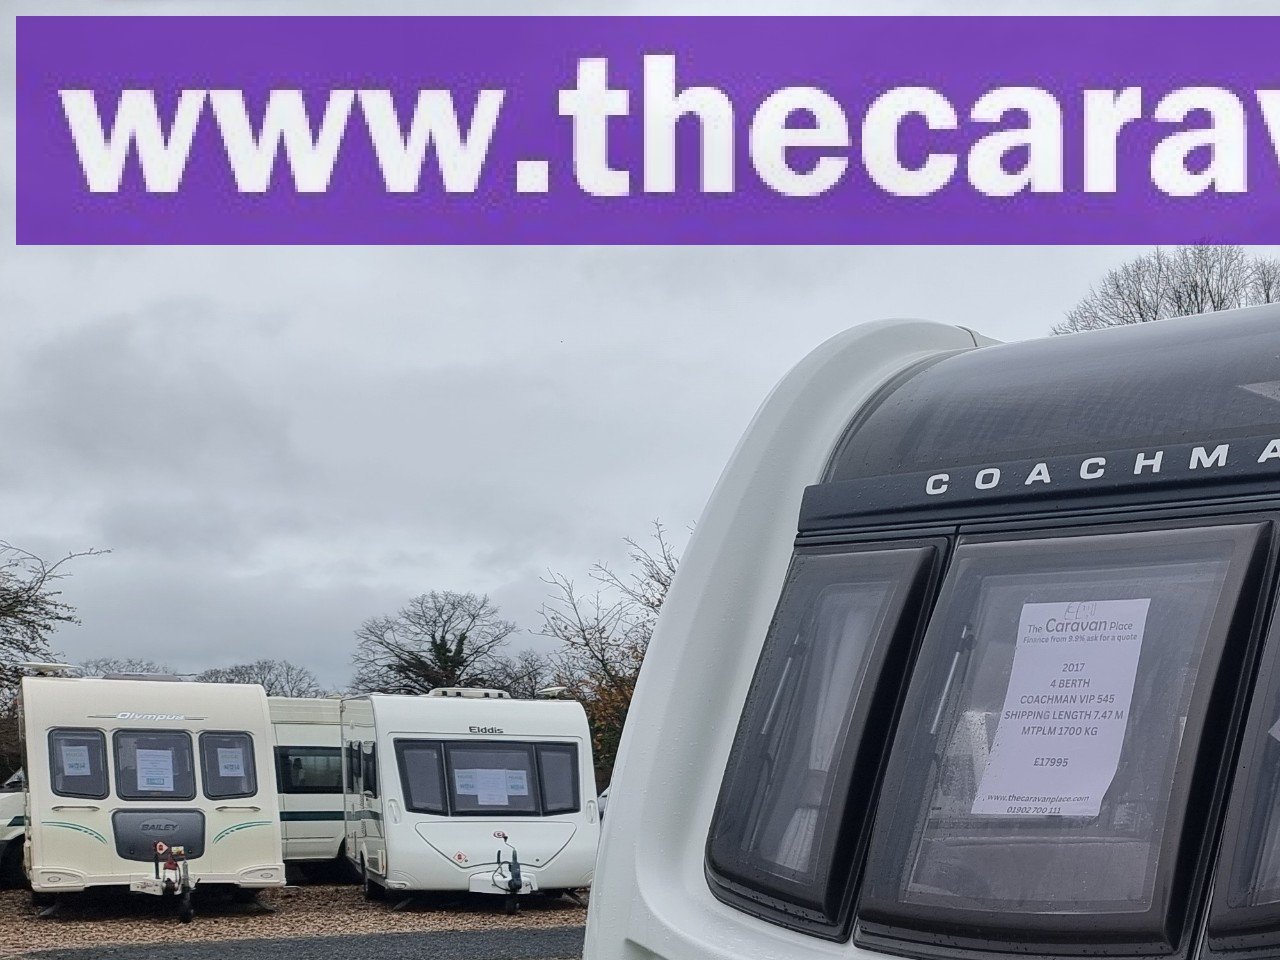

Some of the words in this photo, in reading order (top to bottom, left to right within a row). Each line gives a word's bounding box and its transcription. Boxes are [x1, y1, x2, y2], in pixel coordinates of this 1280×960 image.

[1027, 624, 1043, 634] The
[1045, 618, 1108, 633] Caravan
[1109, 621, 1134, 631] Place
[1023, 636, 1050, 644] Finance
[1050, 635, 1067, 643] from
[1099, 635, 1110, 643] for
[1116, 634, 1138, 643] quote
[1062, 662, 1086, 672] 2017
[1050, 679, 1056, 688] 4
[1058, 678, 1091, 689] BERTH
[1020, 694, 1077, 705] COACHMAN
[1079, 694, 1095, 704] VIP
[1096, 694, 1115, 704] 545
[116, 712, 186, 722] Olympus
[1004, 710, 1050, 720] SHIPPING
[1052, 710, 1092, 720] LENGTH
[1093, 710, 1113, 720] 7.47
[1114, 710, 1124, 720] M
[468, 726, 504, 734] Elddis
[1021, 726, 1057, 736] MTPLM
[1058, 726, 1082, 736] 1700
[1083, 726, 1099, 736] KG
[1033, 757, 1069, 768] £17995
[987, 793, 1090, 805] www.thecaravanplace.com
[1006, 806, 1032, 814] 01902
[1031, 806, 1048, 814] 700
[1048, 806, 1062, 814] 111
